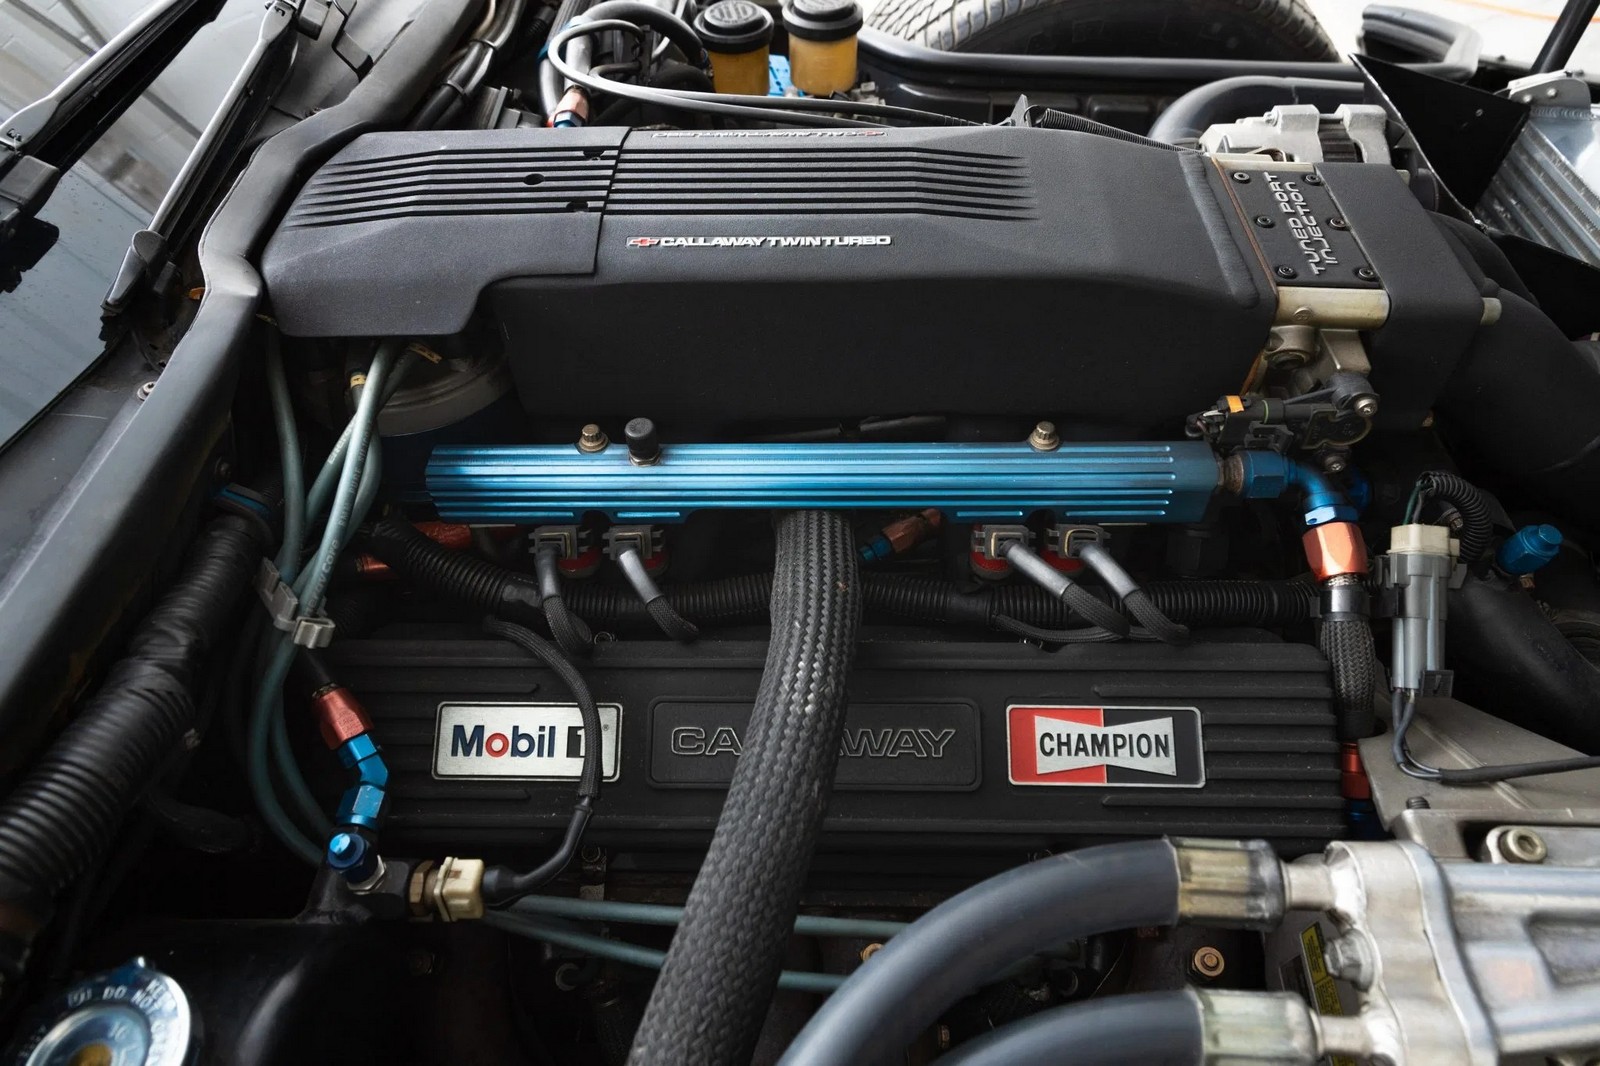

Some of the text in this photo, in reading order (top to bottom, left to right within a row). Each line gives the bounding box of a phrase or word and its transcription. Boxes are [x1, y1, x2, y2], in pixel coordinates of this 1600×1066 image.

[1263, 171, 1326, 275] TUNED PORT
[1284, 181, 1338, 264] INJECTION
[450, 724, 556, 758] Mobil
[671, 727, 956, 757] CAWAY
[1039, 732, 1171, 758] CHAMPION
[102, 985, 127, 1000] DO
[131, 989, 163, 1016] NOT
